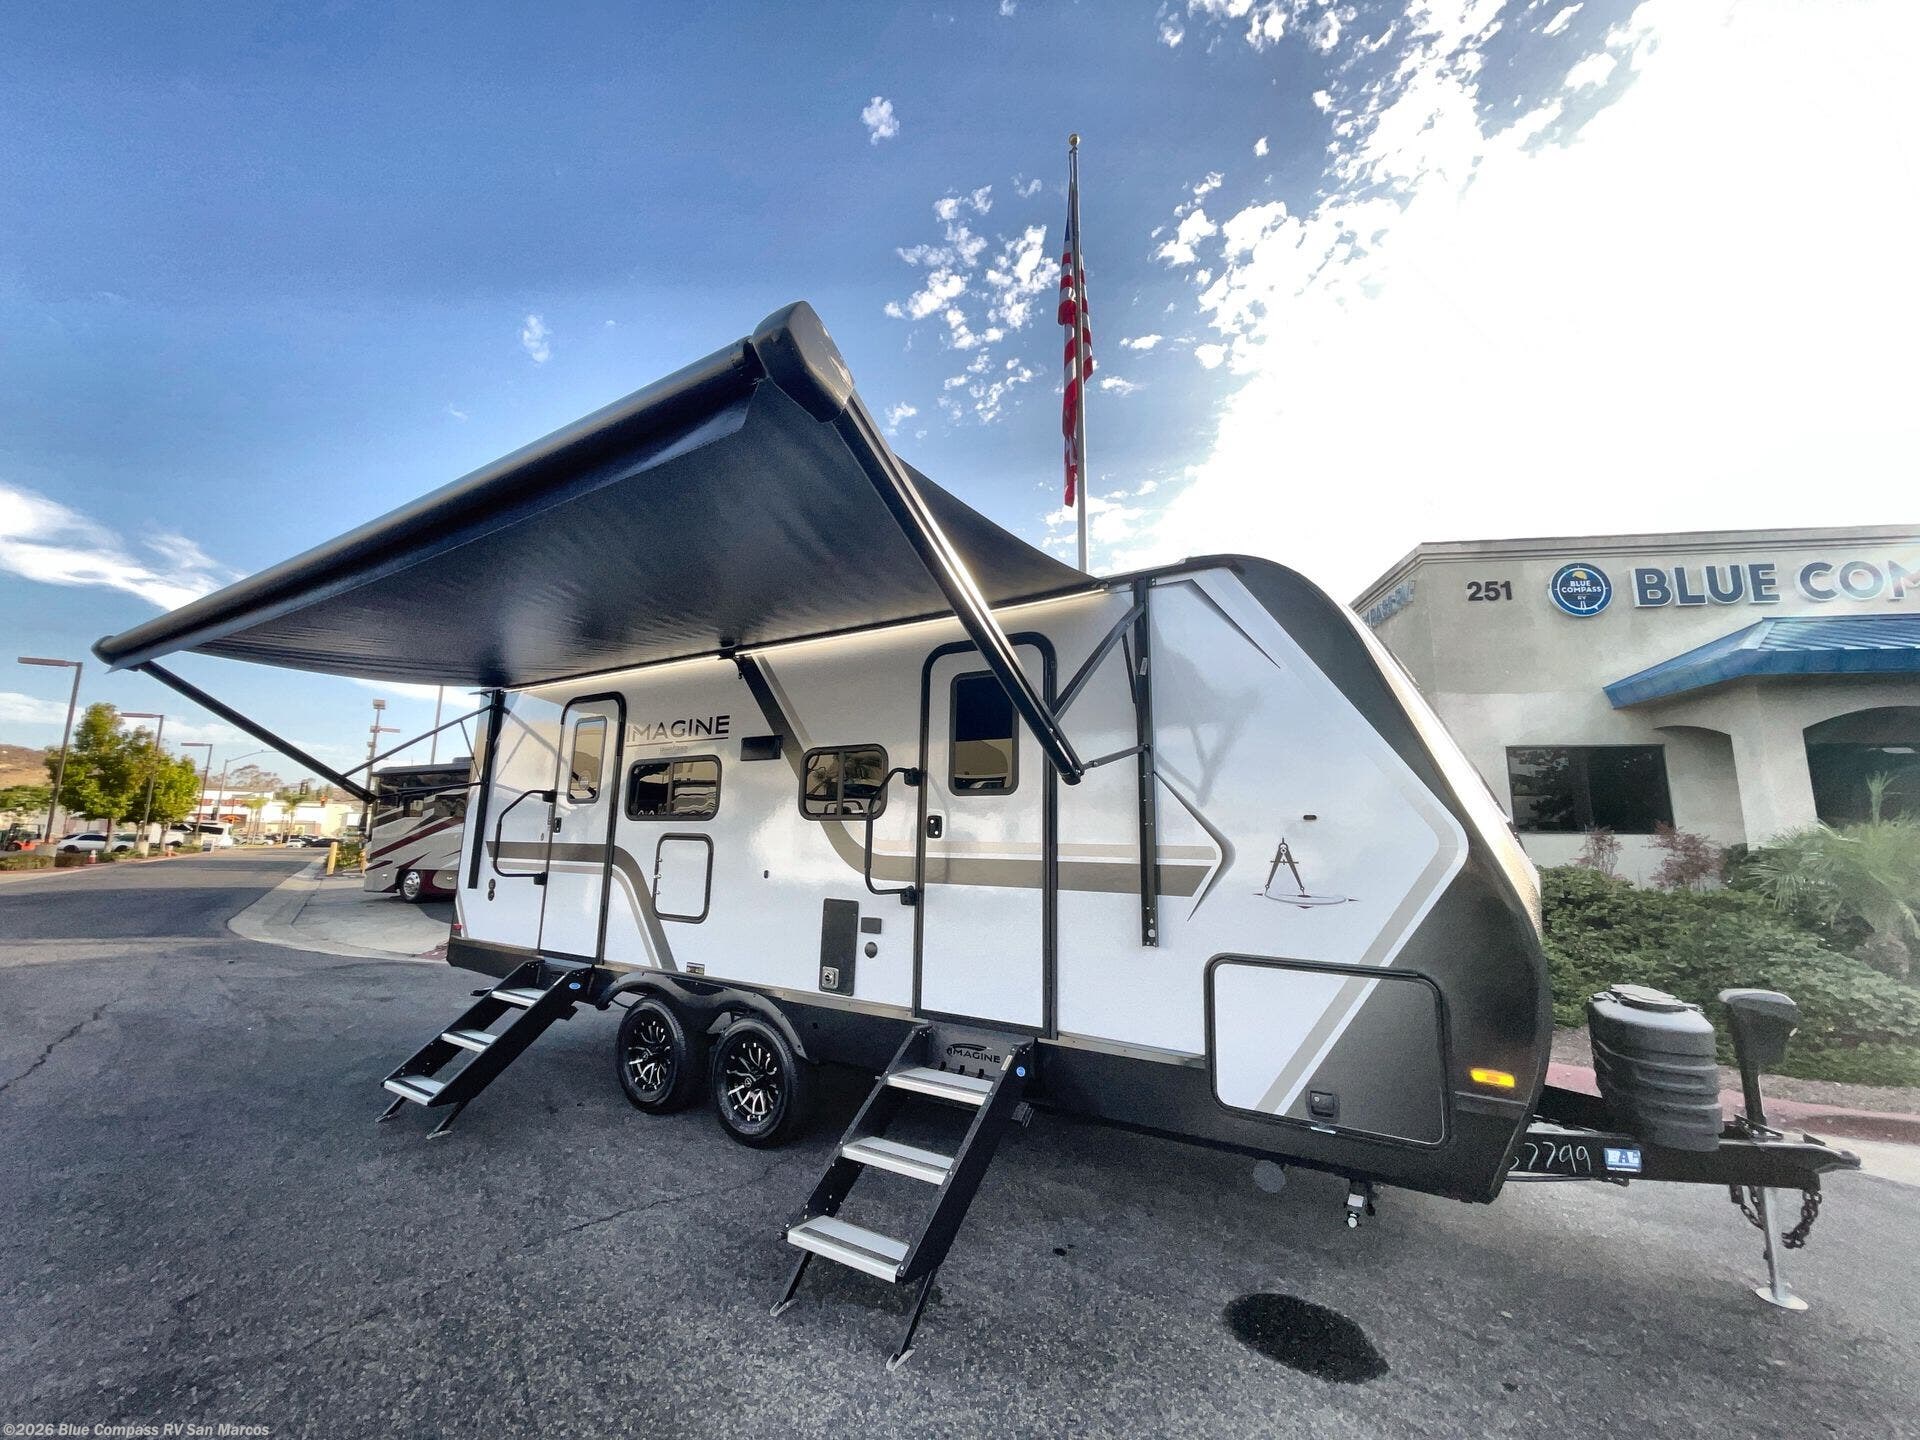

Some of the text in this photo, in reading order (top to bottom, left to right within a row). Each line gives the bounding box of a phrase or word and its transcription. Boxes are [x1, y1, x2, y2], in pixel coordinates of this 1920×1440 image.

[1467, 581, 1512, 601] 251
[1633, 563, 1781, 608] BLUE
[626, 715, 730, 742] IMAGINE
